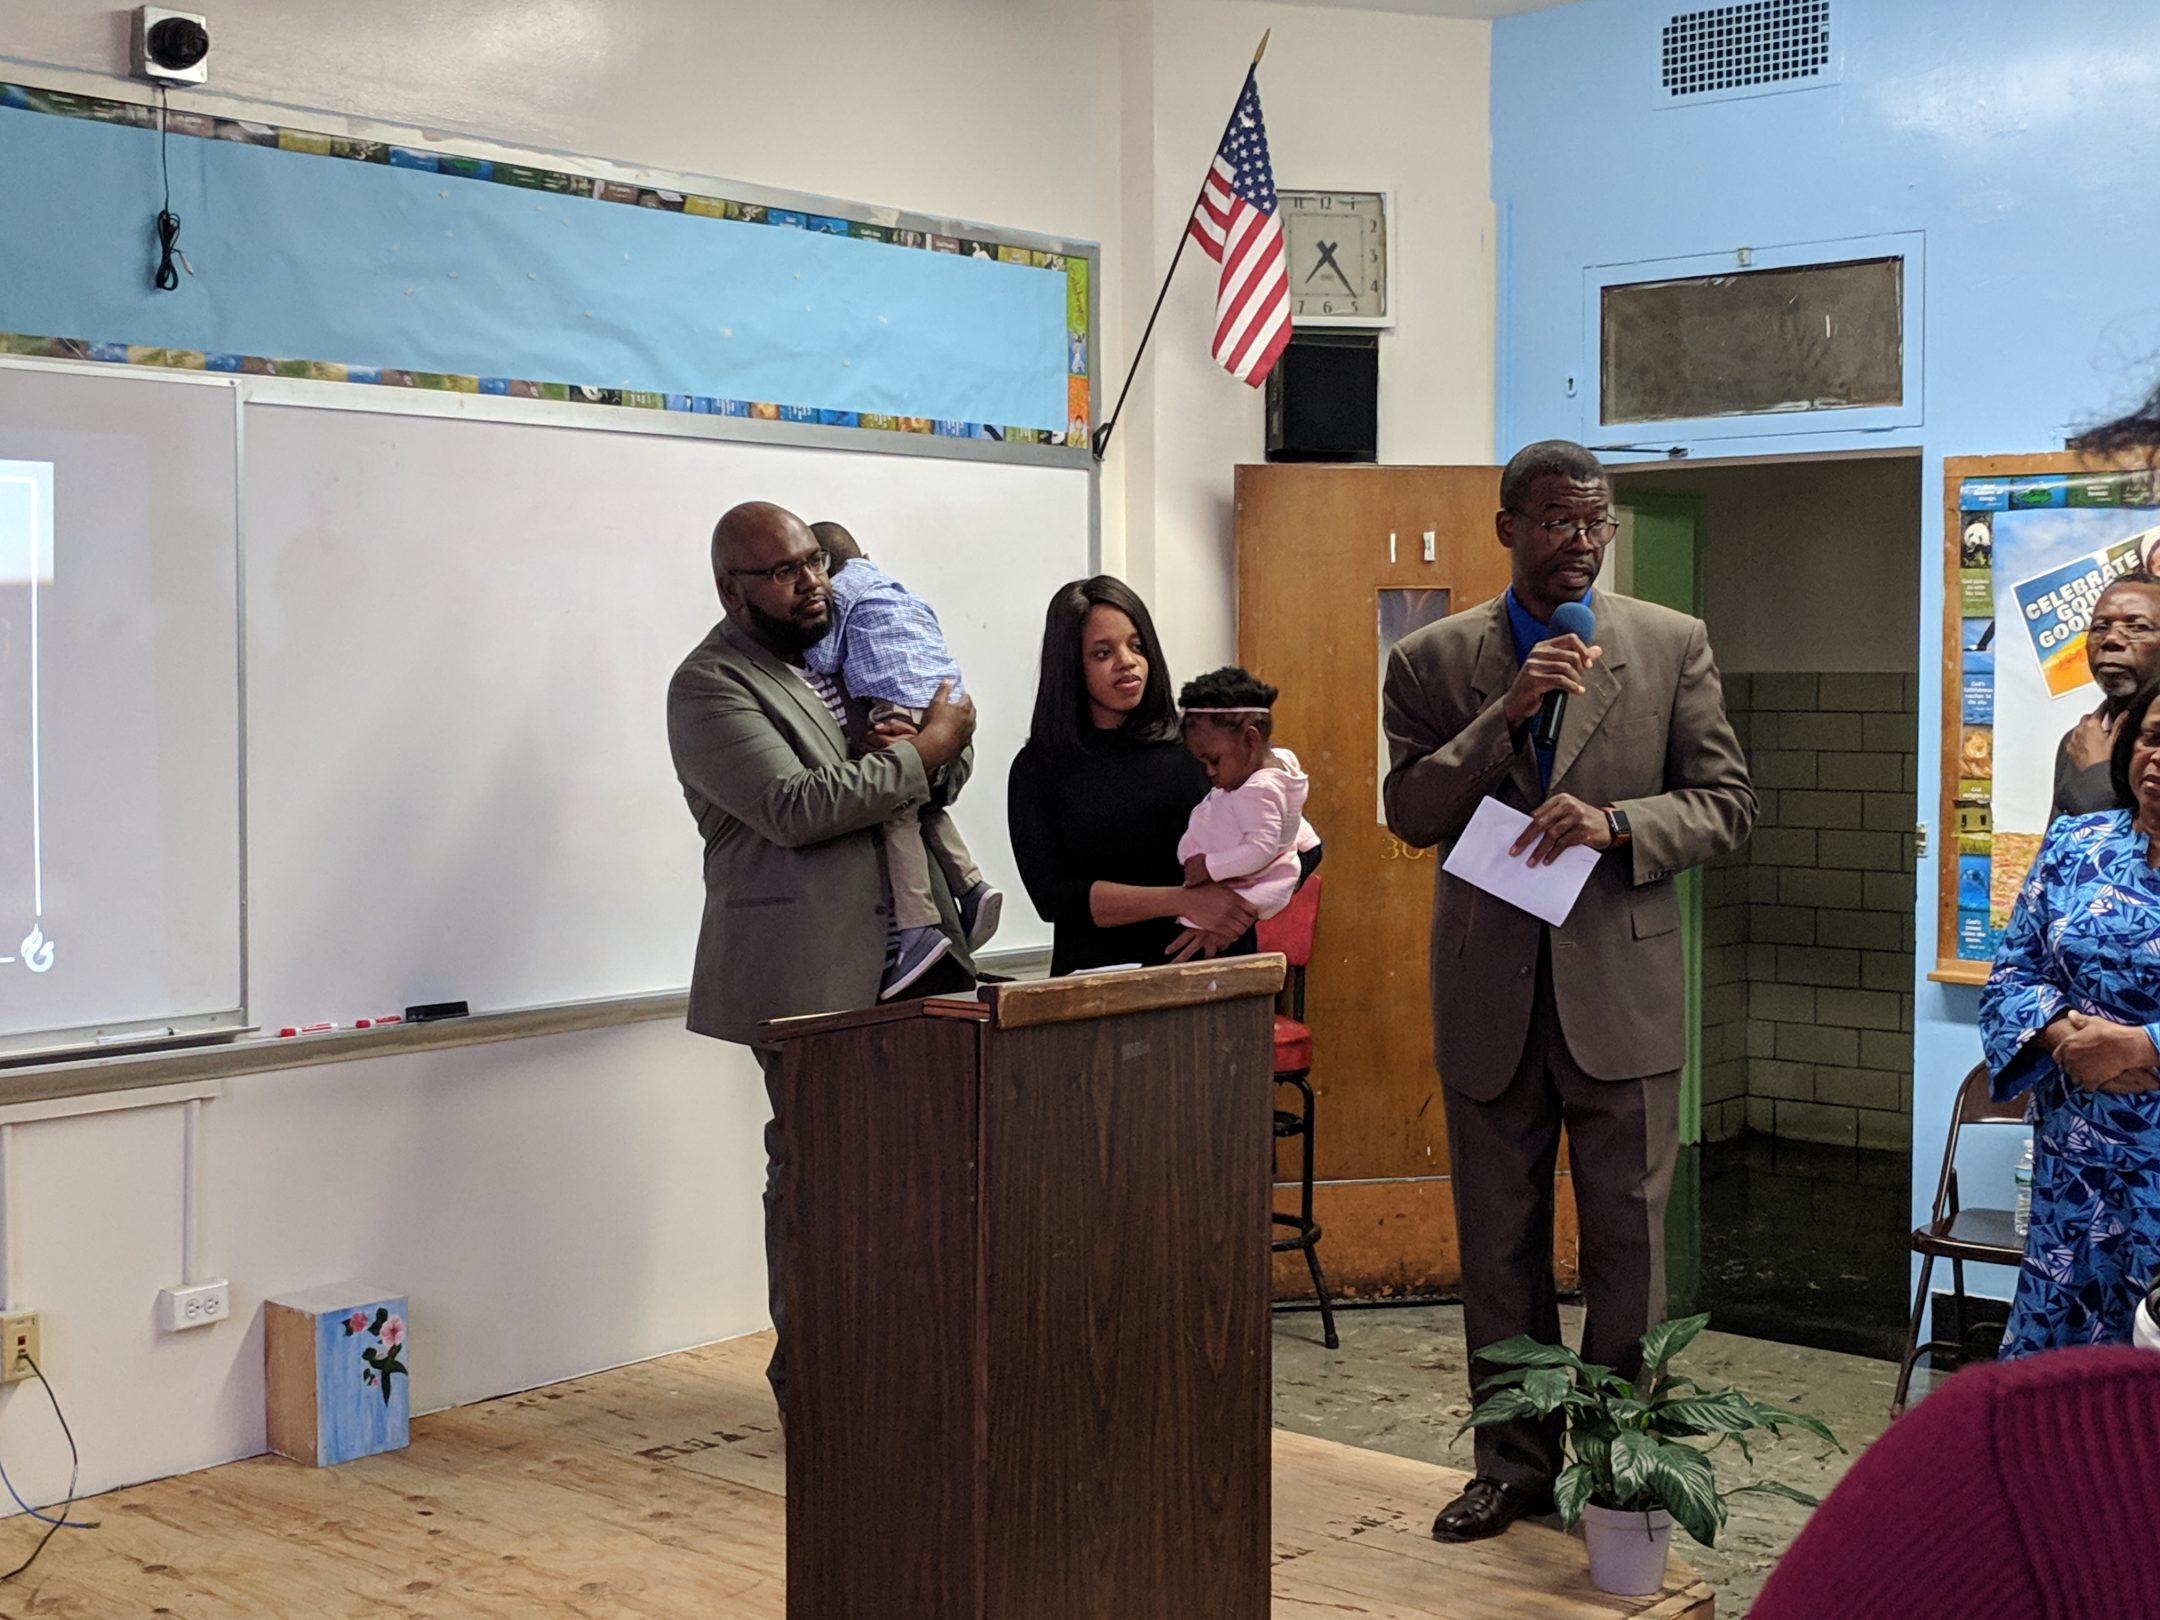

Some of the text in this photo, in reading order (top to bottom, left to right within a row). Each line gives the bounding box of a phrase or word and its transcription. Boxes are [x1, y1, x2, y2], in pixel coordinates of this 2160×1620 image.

[1320, 197, 1332, 210] 12
[1368, 218, 1378, 233] 2
[1369, 249, 1378, 263] 3
[1369, 279, 1379, 293] 4
[1298, 300, 1306, 314] 7
[1323, 301, 1333, 314] 6
[2025, 548, 2140, 621] CELEBRATE
[1380, 838, 1436, 860] 30
